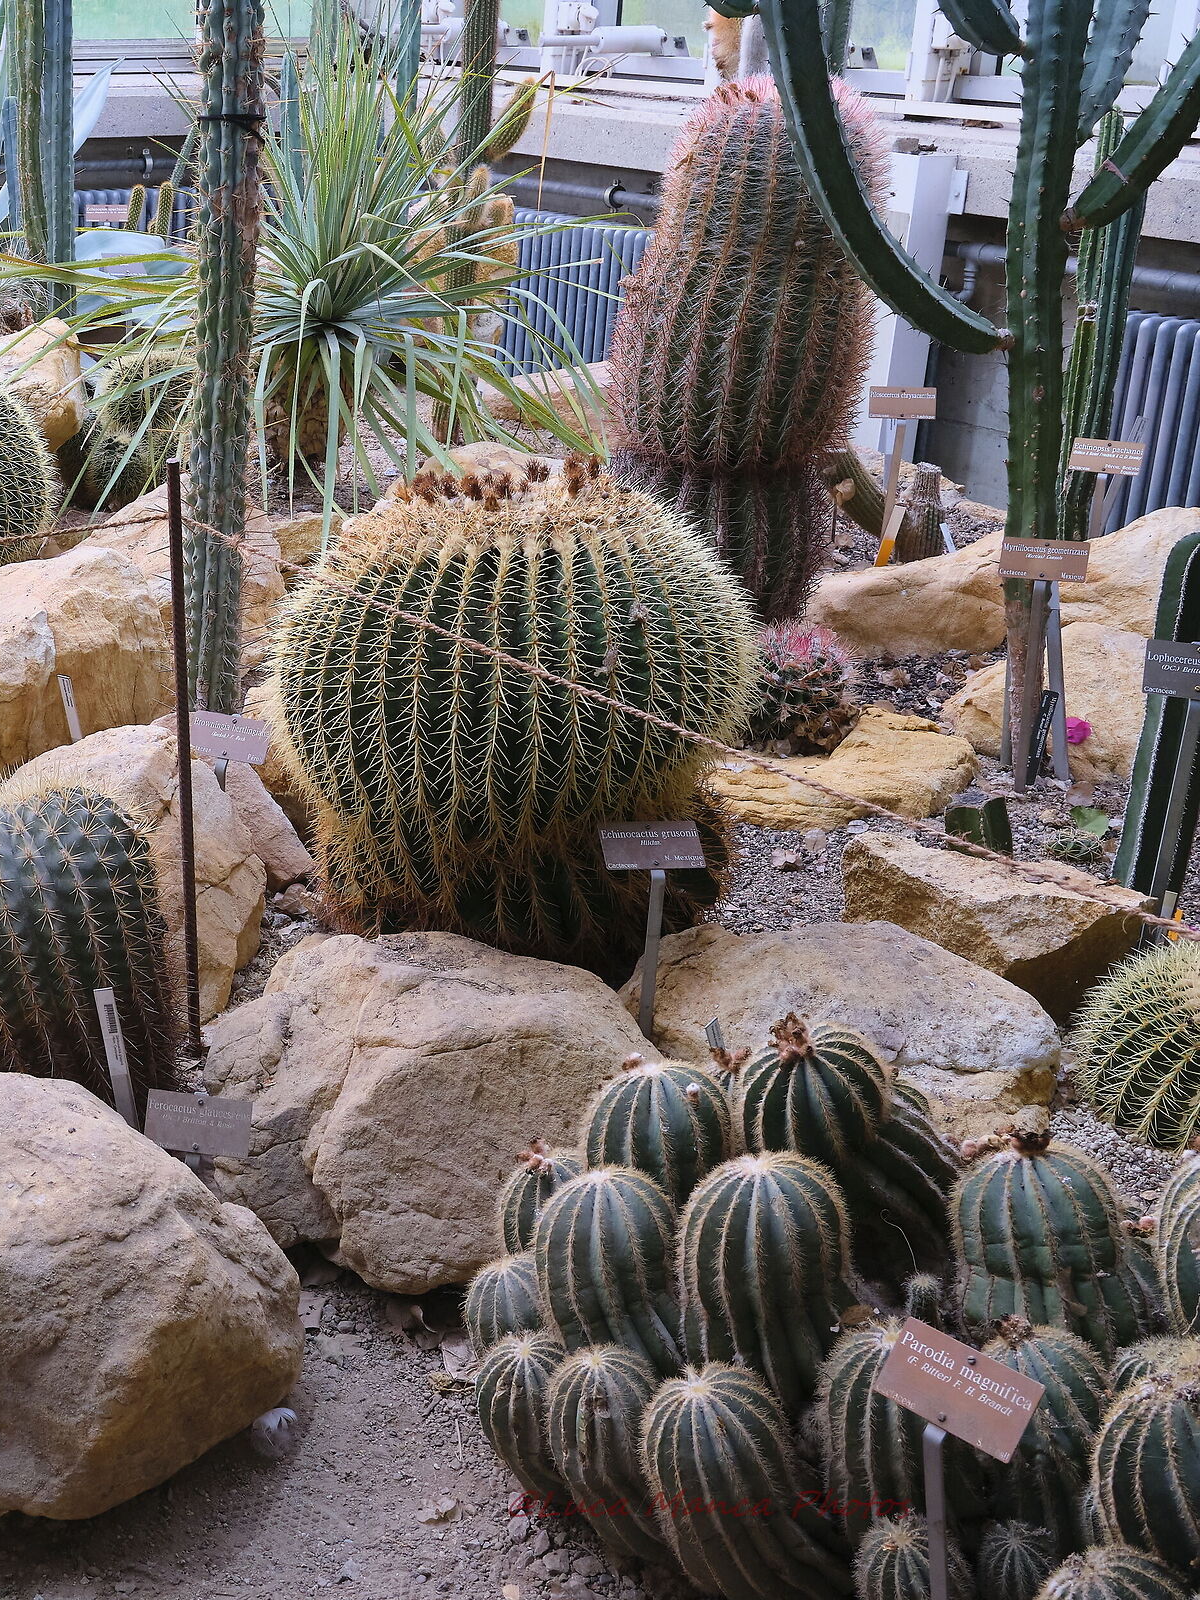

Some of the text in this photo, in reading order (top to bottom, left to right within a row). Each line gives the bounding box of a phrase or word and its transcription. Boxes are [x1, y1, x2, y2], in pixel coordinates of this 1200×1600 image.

[600, 827, 698, 840] Echinocactus grusonii
[148, 1099, 198, 1115] Ferocactus
[901, 1330, 1033, 1411] Parodia magnifica
[907, 1355, 1013, 1417] (F. Ritter) F. H. Brandt
